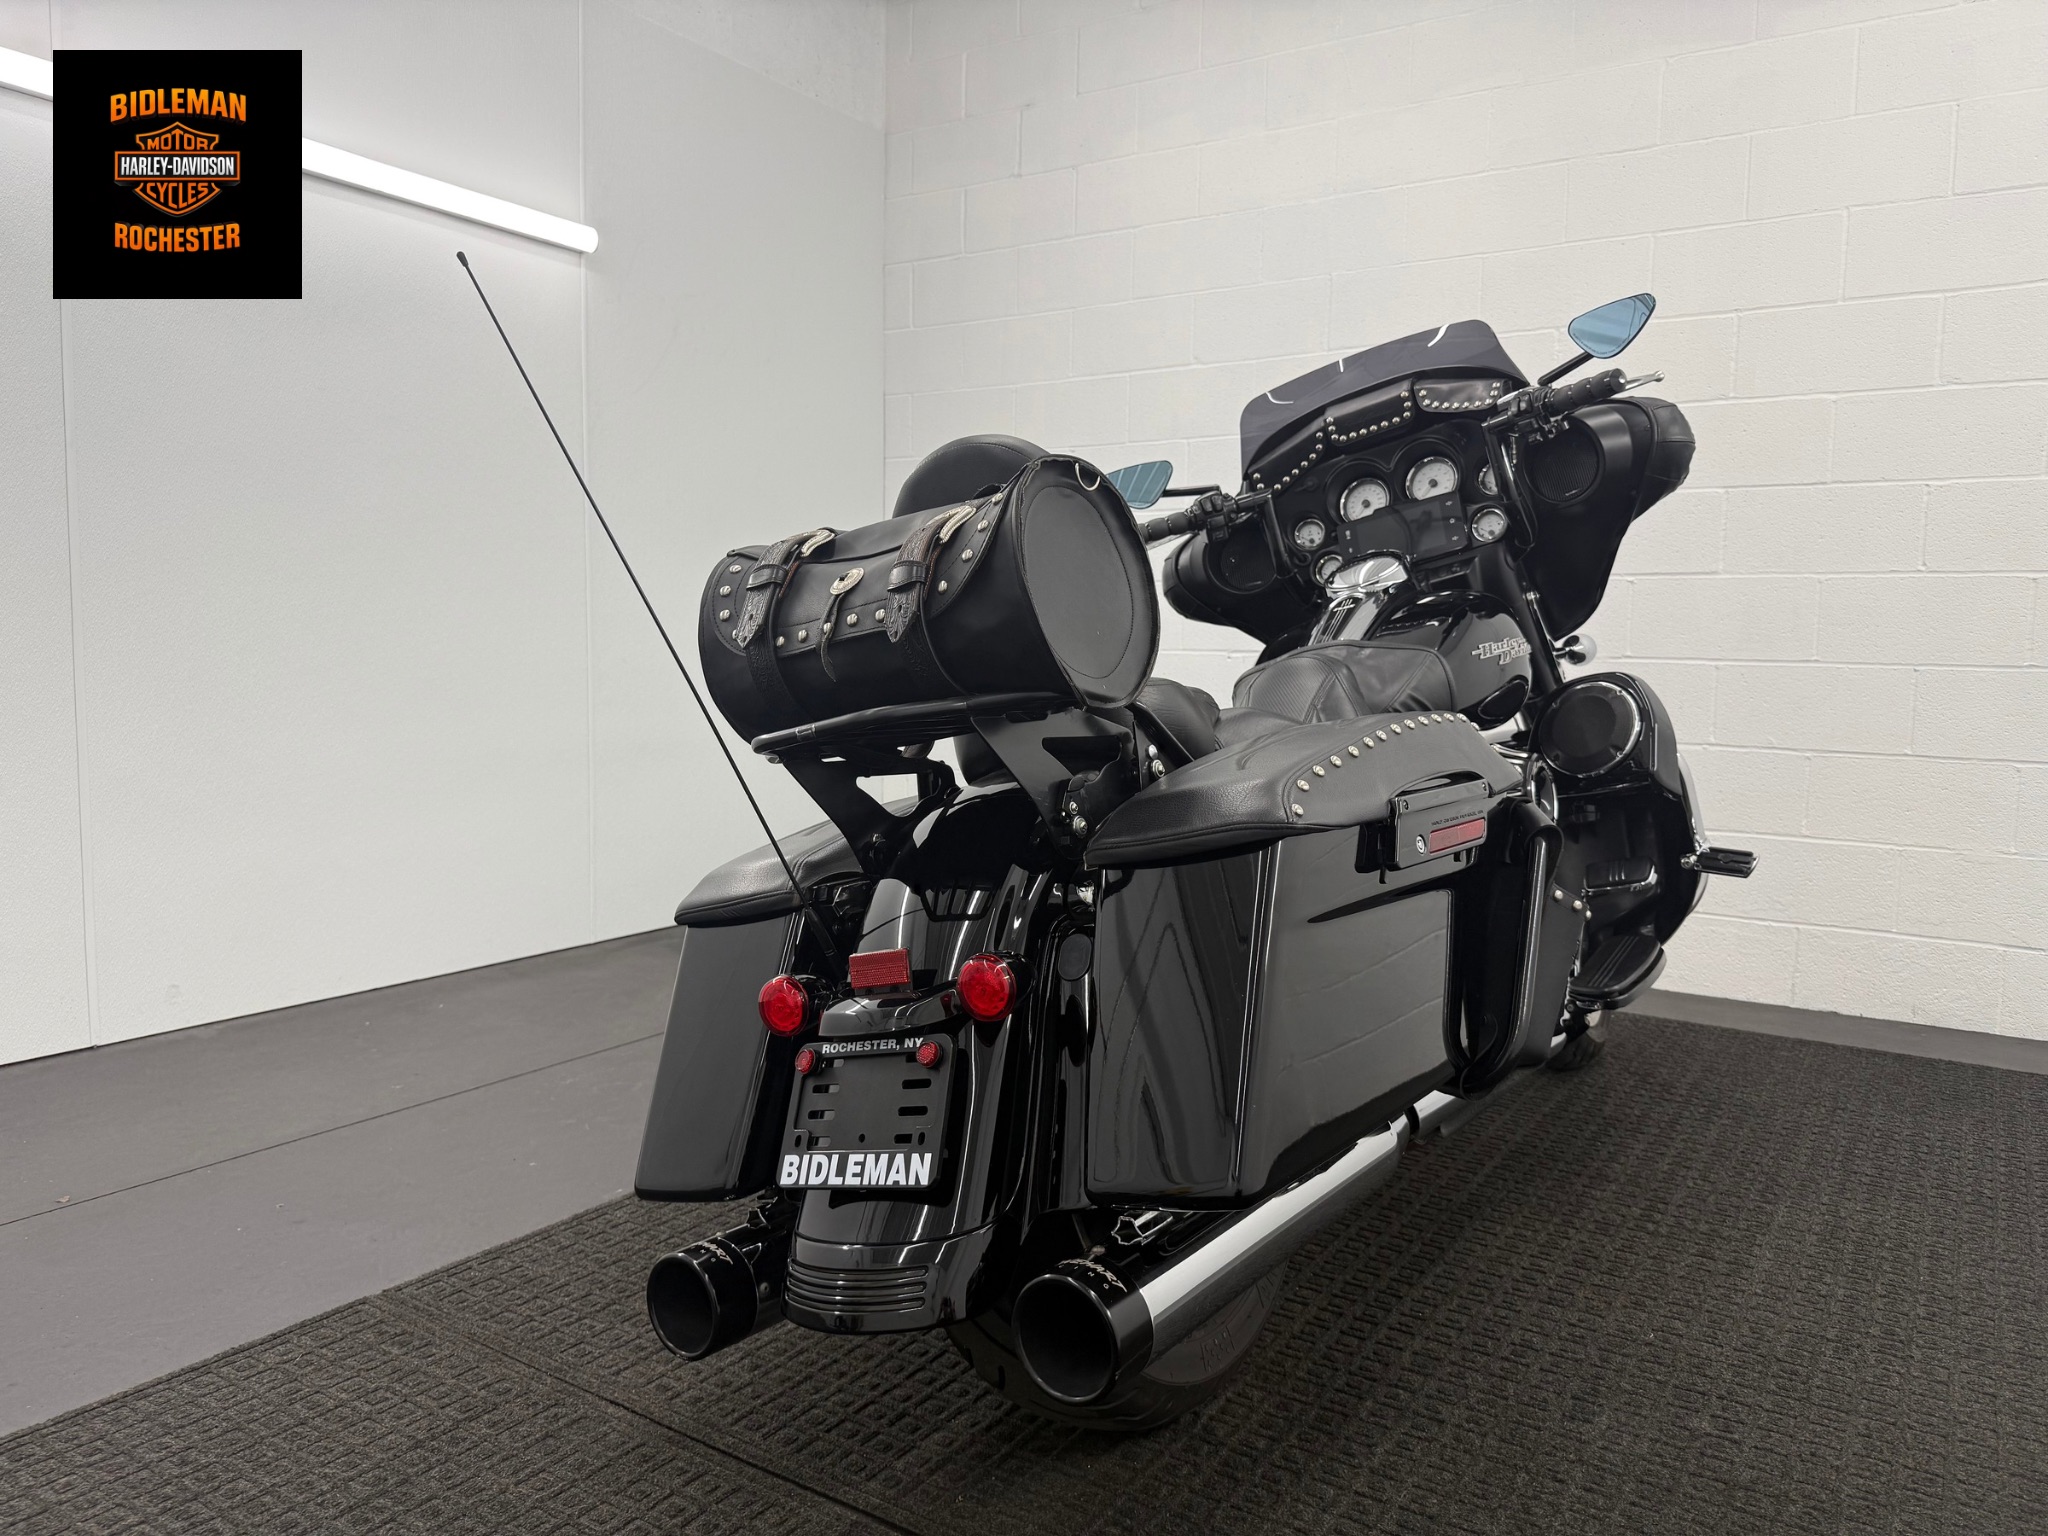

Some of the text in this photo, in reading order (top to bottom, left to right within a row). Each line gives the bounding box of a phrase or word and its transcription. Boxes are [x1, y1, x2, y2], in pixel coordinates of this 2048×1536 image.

[822, 1037, 924, 1054] ROCHESTER, NY
[779, 1152, 933, 1186] BIDLEMAN
